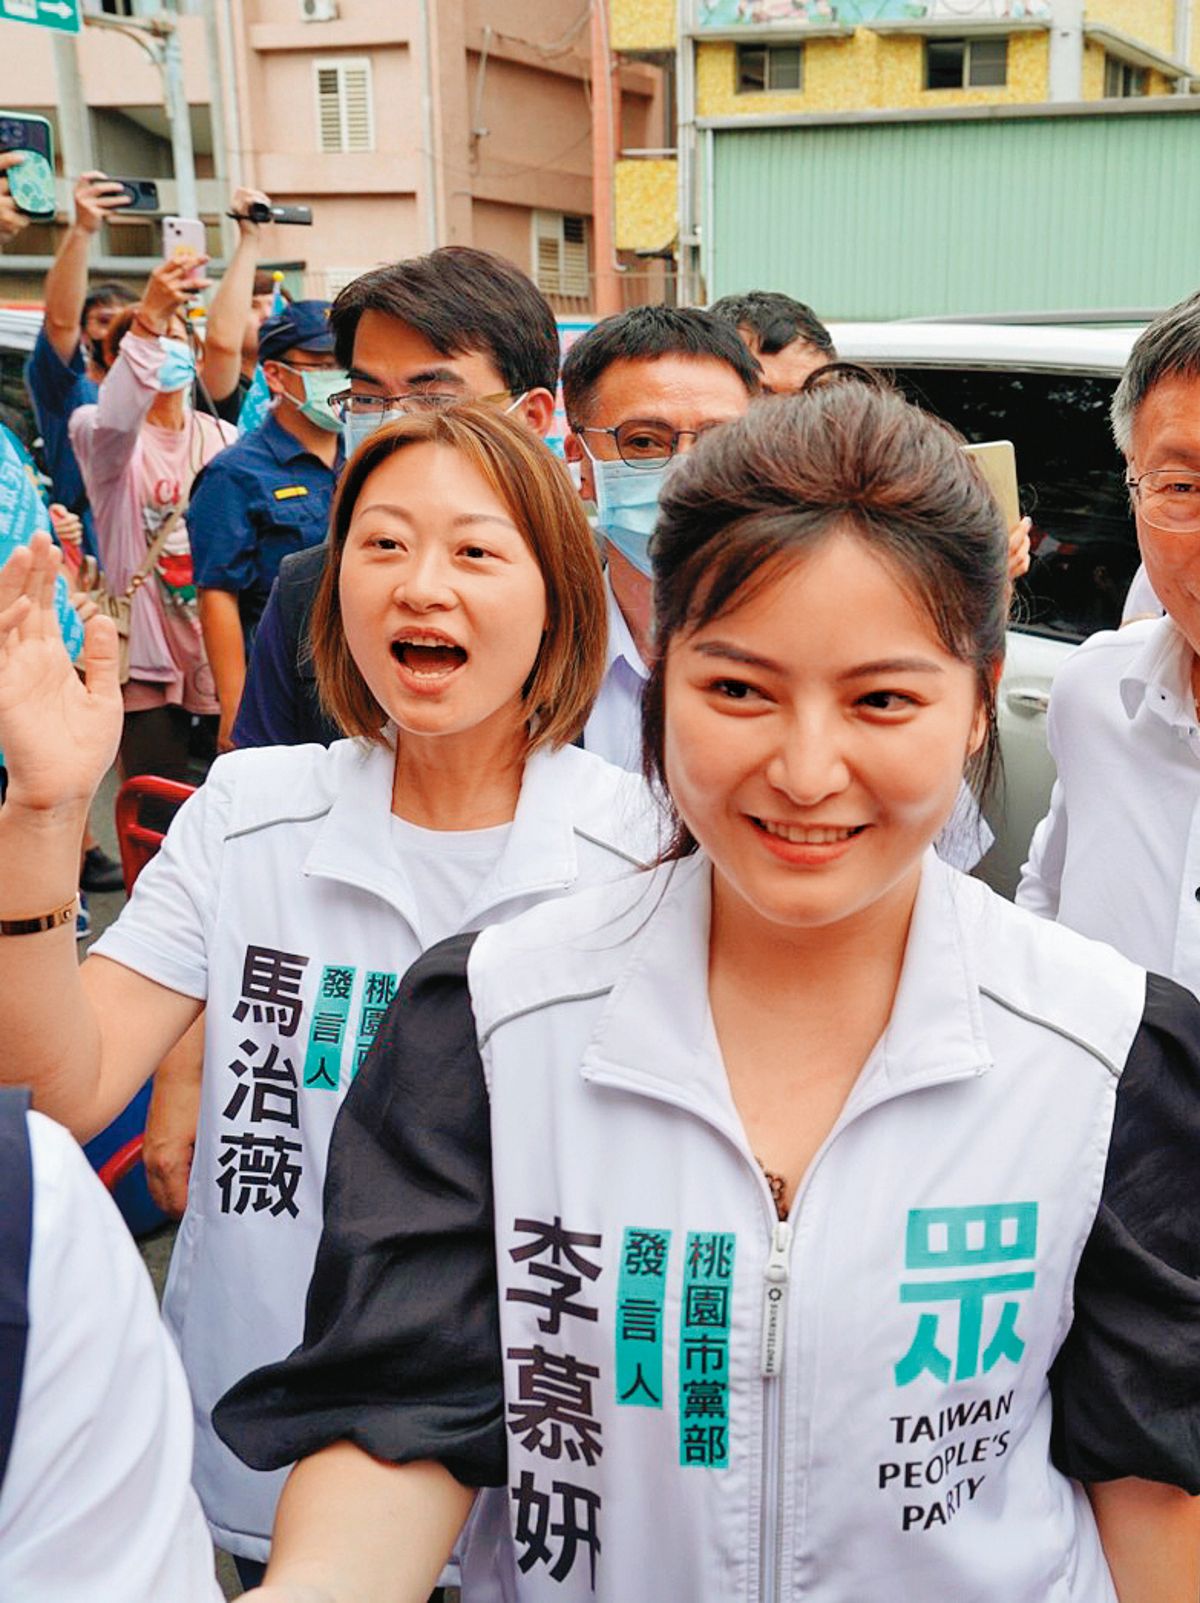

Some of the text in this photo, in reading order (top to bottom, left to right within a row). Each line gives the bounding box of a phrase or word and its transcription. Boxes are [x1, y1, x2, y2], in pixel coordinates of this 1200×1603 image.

[215, 945, 310, 1219] 馬治薇
[305, 968, 354, 1087] 發言人
[620, 1231, 667, 1403] 發言人
[683, 1235, 733, 1466] 桃園市黨部
[506, 1216, 603, 1592] 李慕妍
[890, 1390, 1014, 1444] TAIWAN
[902, 1475, 986, 1532] PARTY
